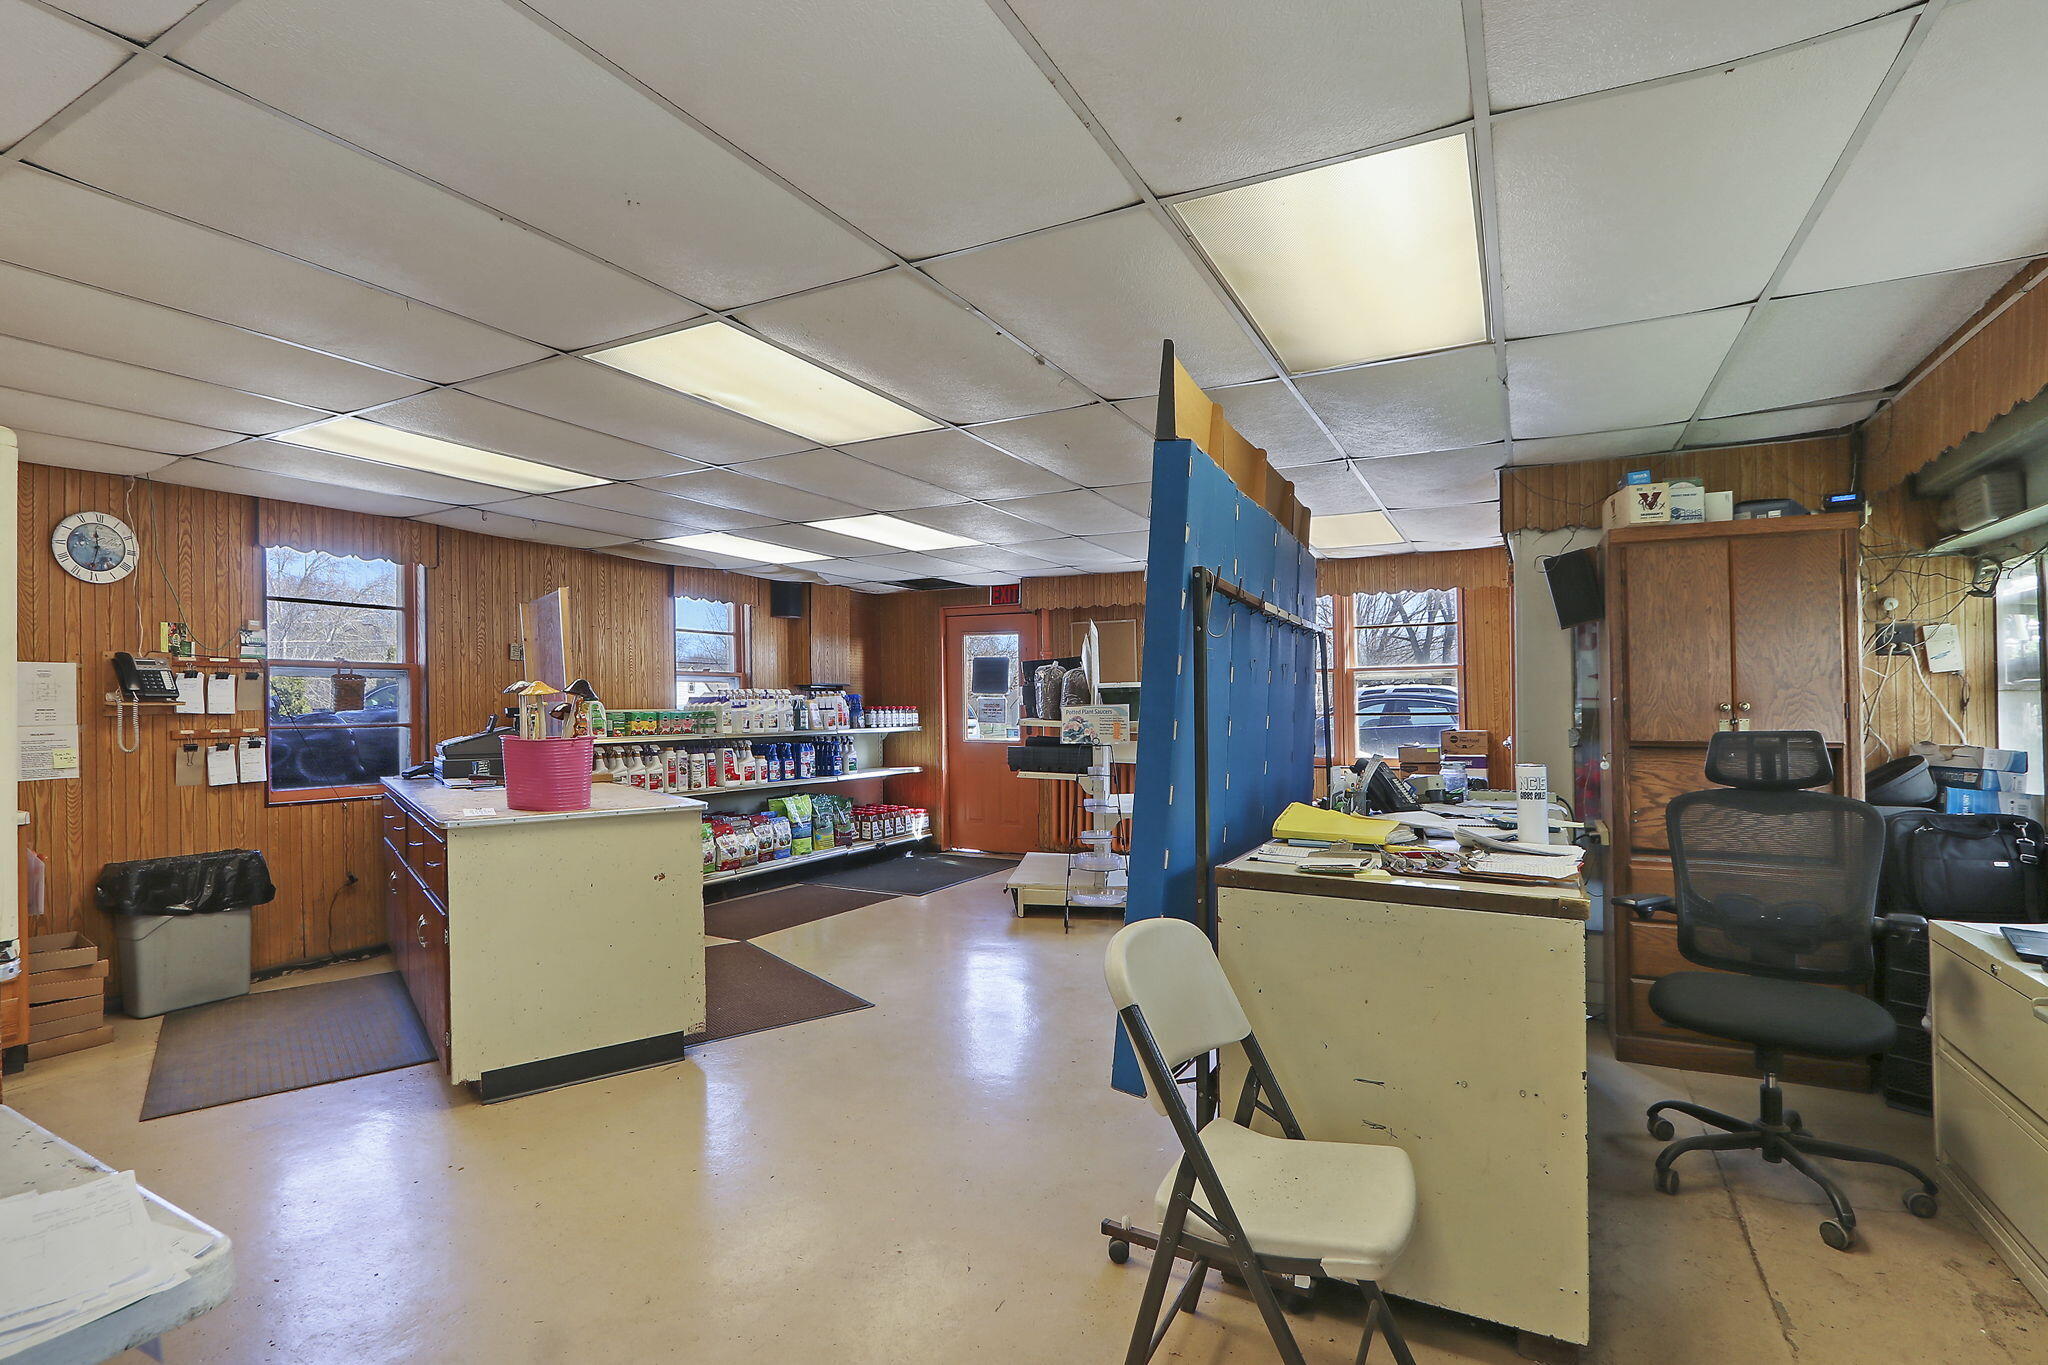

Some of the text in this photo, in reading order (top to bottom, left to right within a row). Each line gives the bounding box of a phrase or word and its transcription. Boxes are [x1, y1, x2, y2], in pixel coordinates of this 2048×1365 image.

[993, 585, 1018, 604] EXIT
[1520, 776, 1546, 790] NCIS
[1520, 791, 1533, 800] GIBBS
